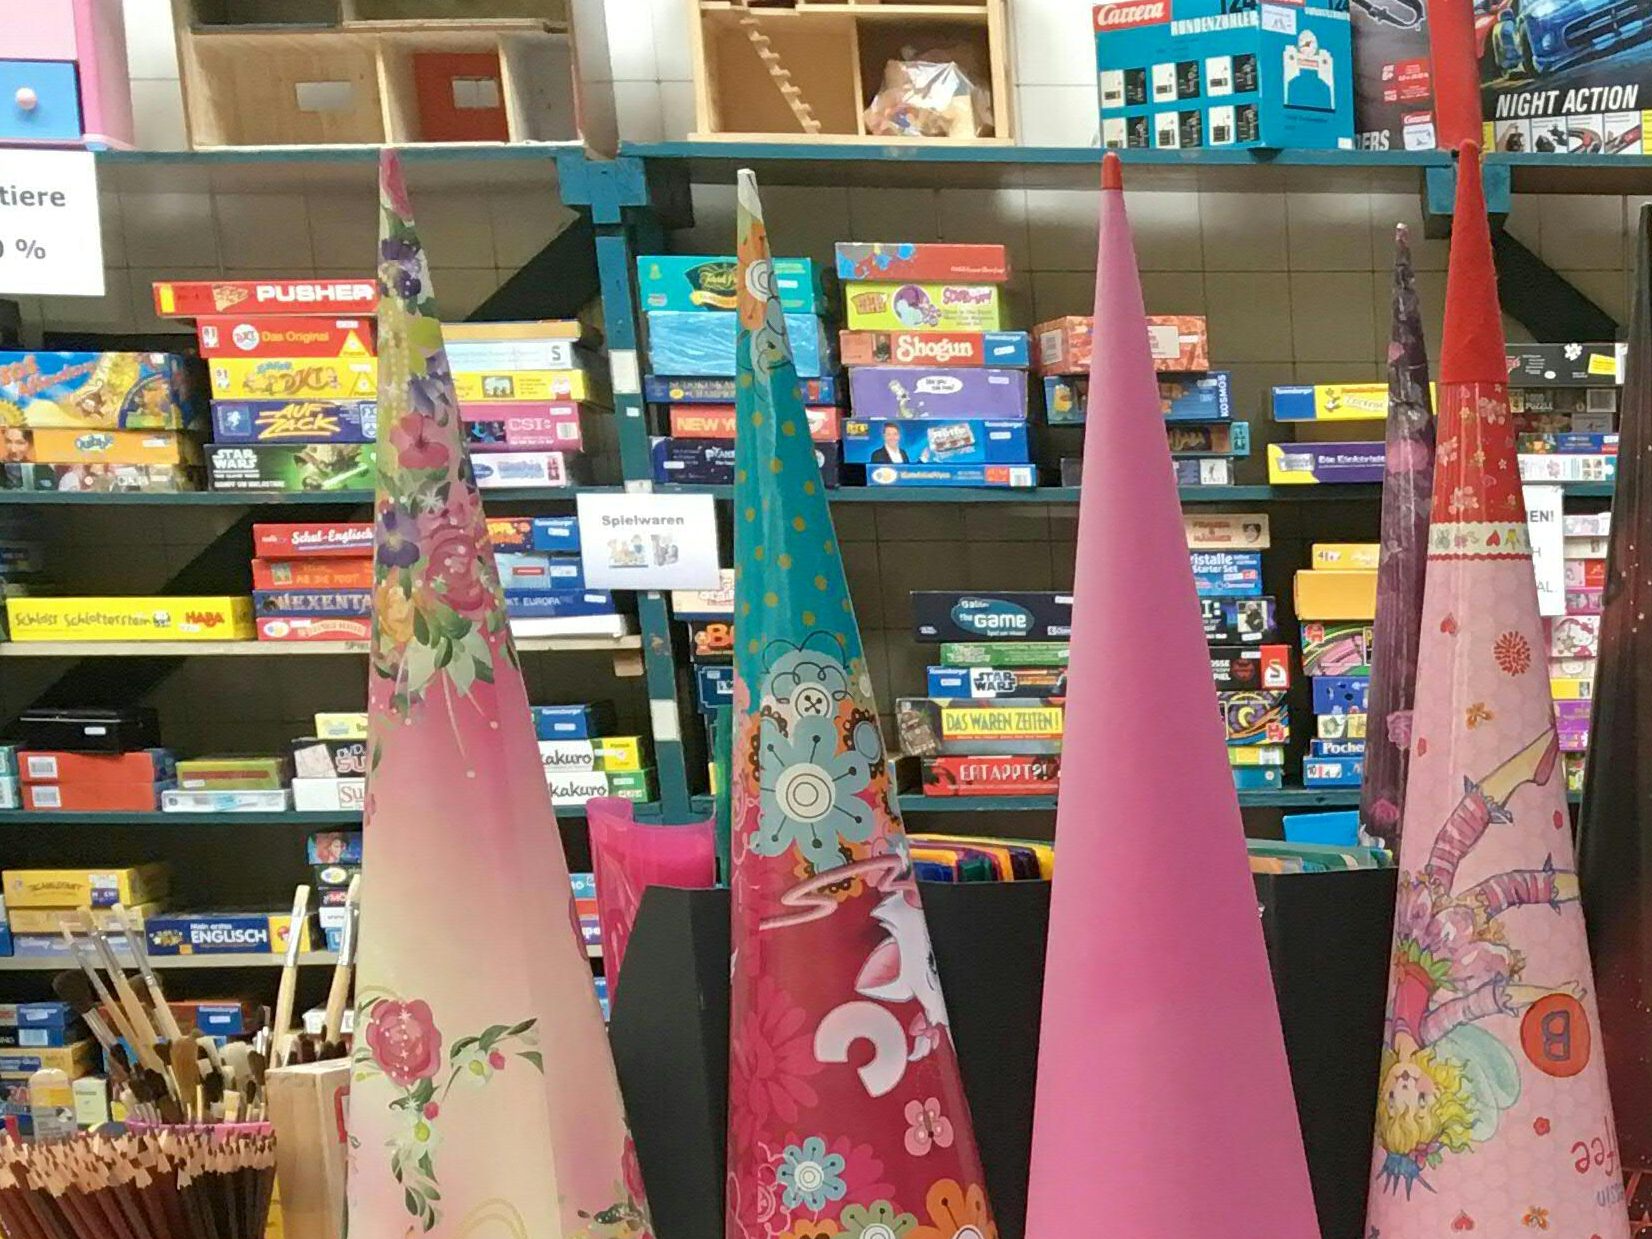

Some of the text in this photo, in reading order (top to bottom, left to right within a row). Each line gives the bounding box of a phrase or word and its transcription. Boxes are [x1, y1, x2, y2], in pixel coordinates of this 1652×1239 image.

[1096, 3, 1165, 26] Carrera
[1495, 84, 1640, 119] NIGHT ACTION
[256, 284, 376, 302] PUSHER
[286, 331, 329, 343] Original
[896, 334, 974, 362] Shogun
[1217, 374, 1230, 417] KOSMOS
[274, 402, 319, 417] AUF
[257, 416, 341, 439] ZACK
[677, 417, 721, 431] NEW
[215, 449, 257, 459] STAR
[213, 459, 258, 469] WARS
[602, 515, 685, 528] Spielwaren
[1526, 510, 1554, 523] EN!
[291, 527, 374, 545] Schul-Englisch
[185, 611, 225, 627] HABA
[974, 613, 1027, 629] Game
[973, 671, 1015, 681] STAR
[973, 681, 1015, 691] WARS
[946, 713, 968, 731] DAS
[970, 713, 1012, 731] WAREN
[190, 929, 267, 944] ENGLISCH
